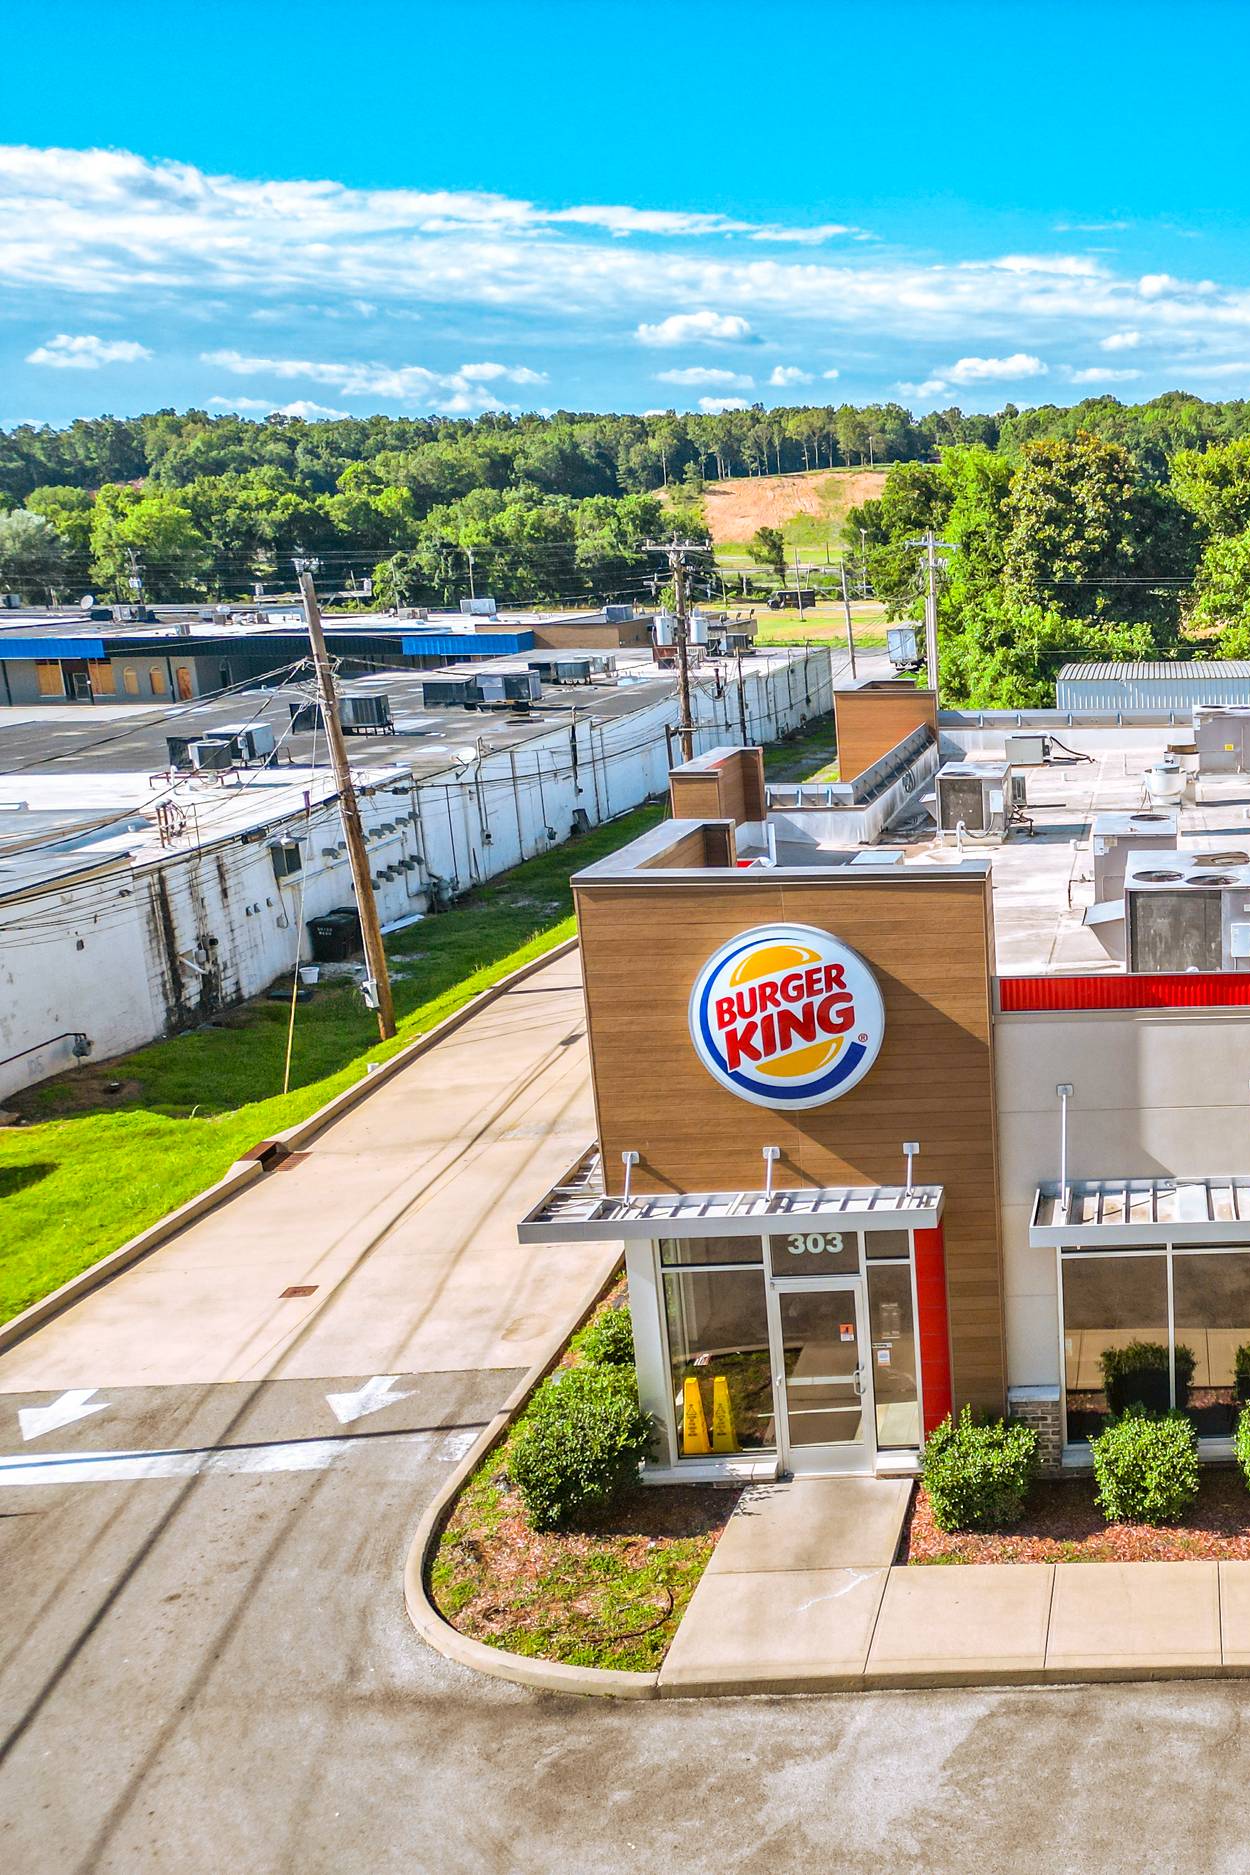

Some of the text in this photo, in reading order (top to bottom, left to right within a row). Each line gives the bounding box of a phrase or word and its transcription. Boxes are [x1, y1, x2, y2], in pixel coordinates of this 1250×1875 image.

[715, 963, 847, 1031] BURGER
[724, 992, 856, 1071] KING
[787, 1232, 844, 1255] 303
